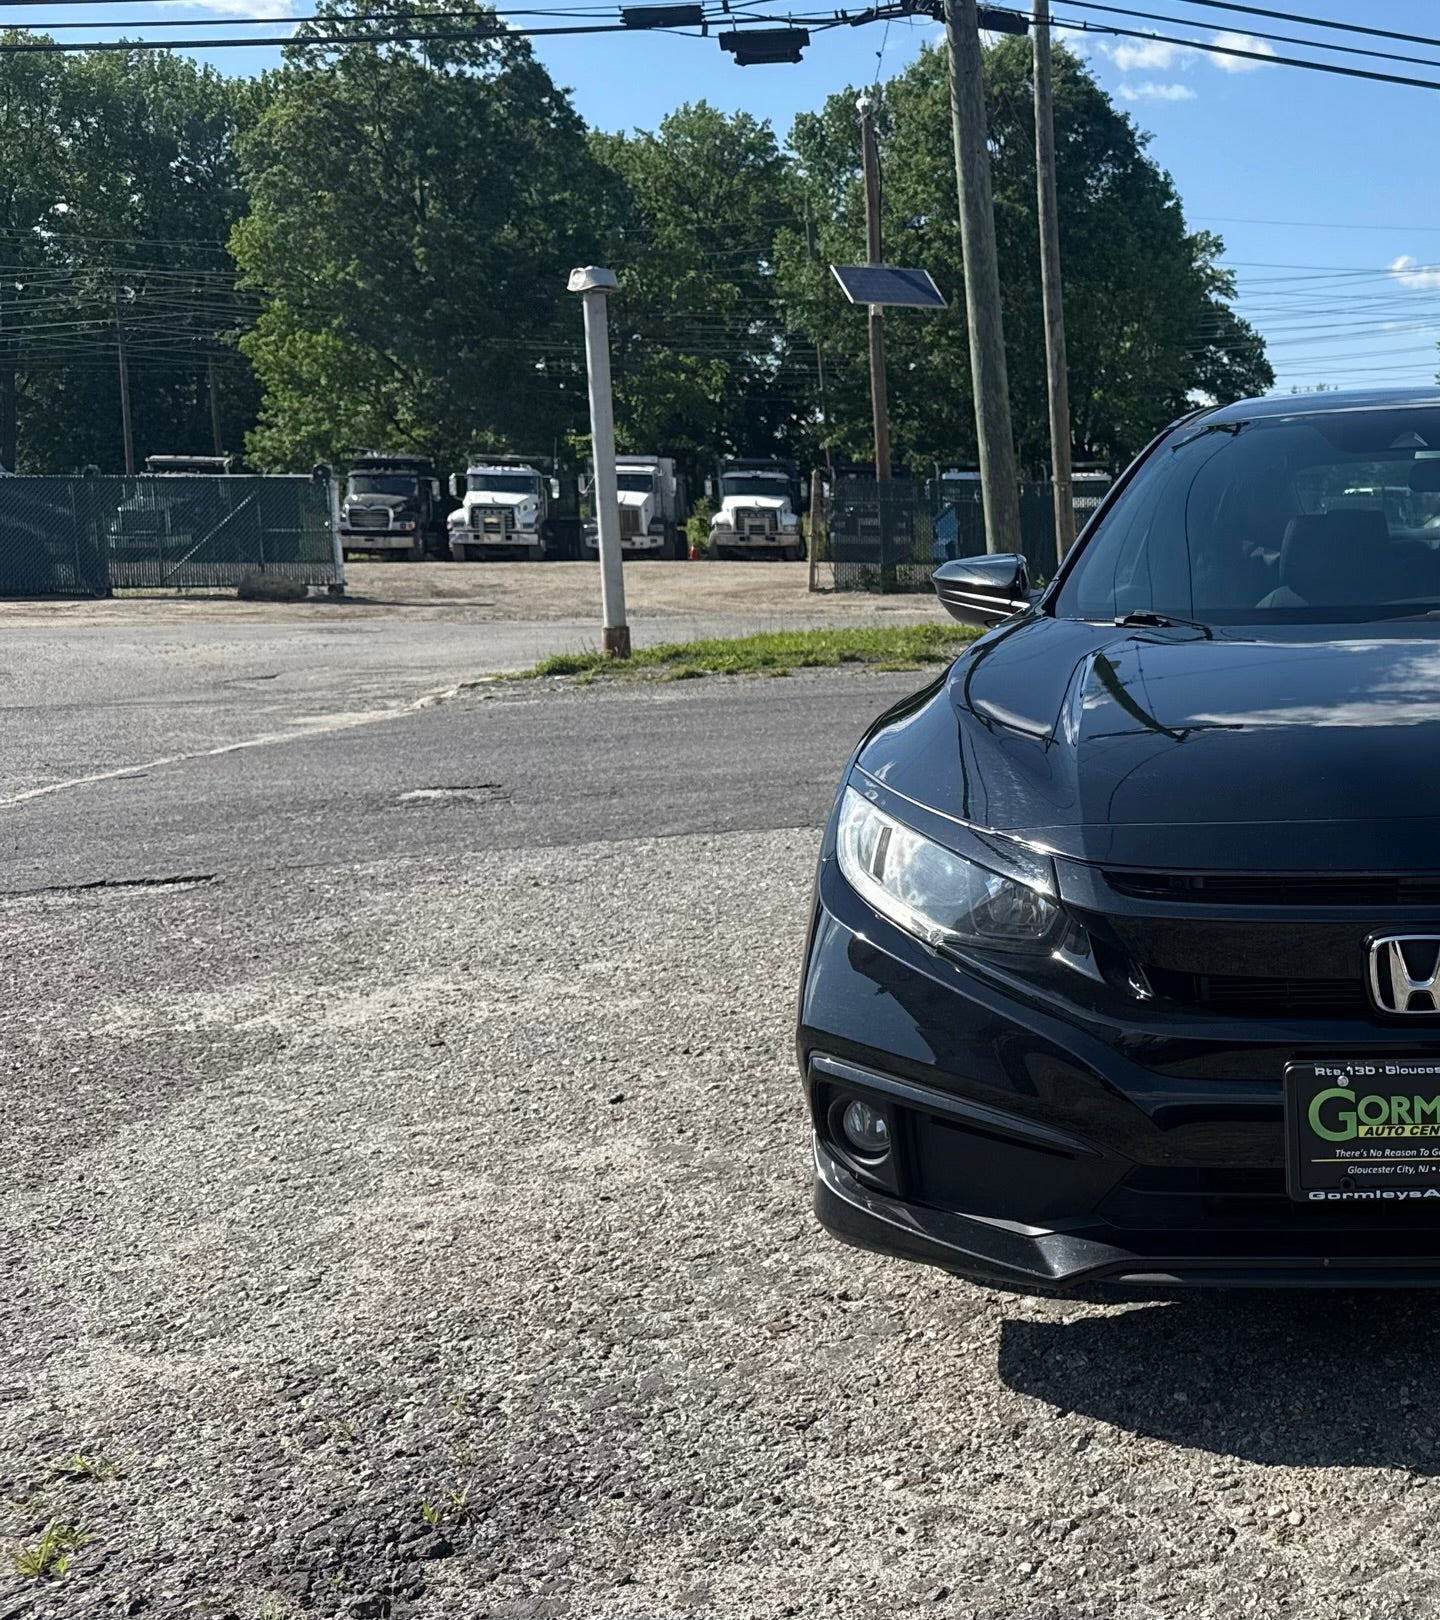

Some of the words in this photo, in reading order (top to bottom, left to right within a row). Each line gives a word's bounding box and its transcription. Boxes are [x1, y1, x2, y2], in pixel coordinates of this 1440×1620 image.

[1314, 1066, 1345, 1076] Rte.
[1364, 1126, 1406, 1137] AUTO
[1335, 1149, 1367, 1158] There's
[1370, 1149, 1382, 1158] No
[1384, 1149, 1418, 1158] Reason
[1420, 1148, 1430, 1157] To
[1347, 1165, 1395, 1175] Gloucester
[1396, 1165, 1416, 1175] City,
[1418, 1164, 1430, 1173] NJ
